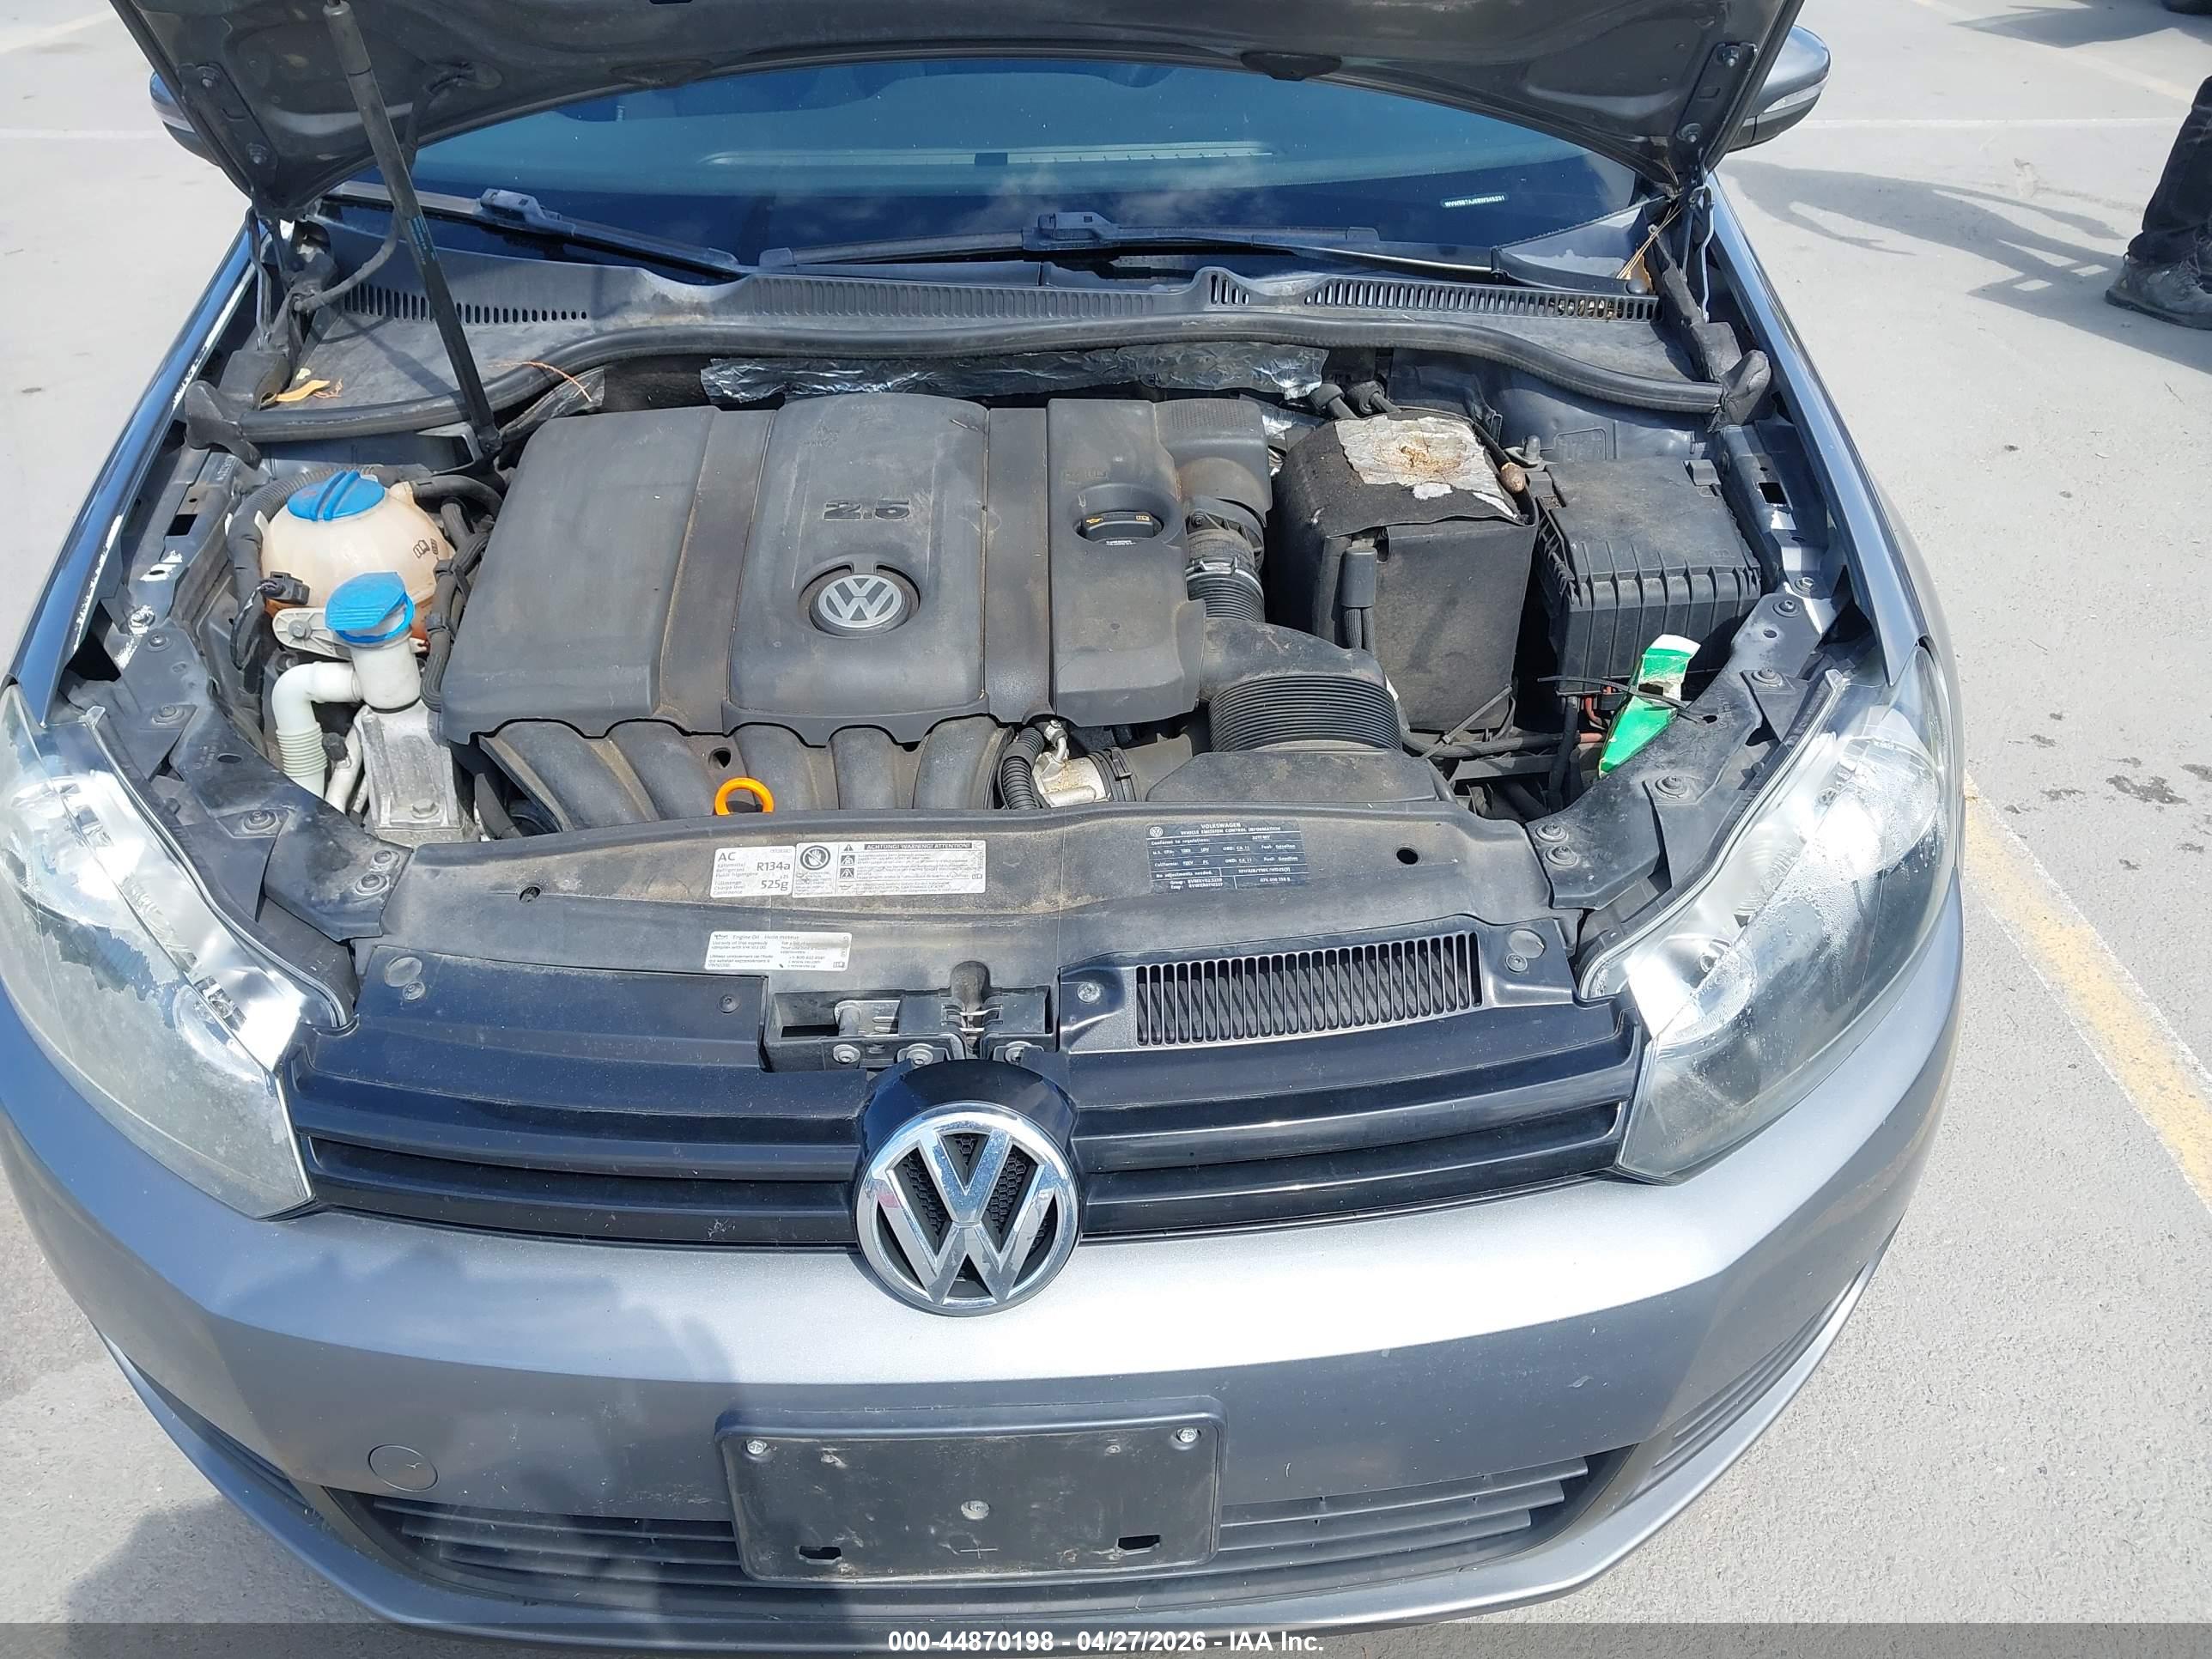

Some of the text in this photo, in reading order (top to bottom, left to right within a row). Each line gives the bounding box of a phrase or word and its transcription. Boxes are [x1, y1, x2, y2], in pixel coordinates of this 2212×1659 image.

[823, 499, 910, 521] 2.5
[718, 852, 736, 861] AC
[757, 861, 790, 871] R134a
[761, 879, 789, 891] 525g
[859, 1103, 1078, 1314] VW
